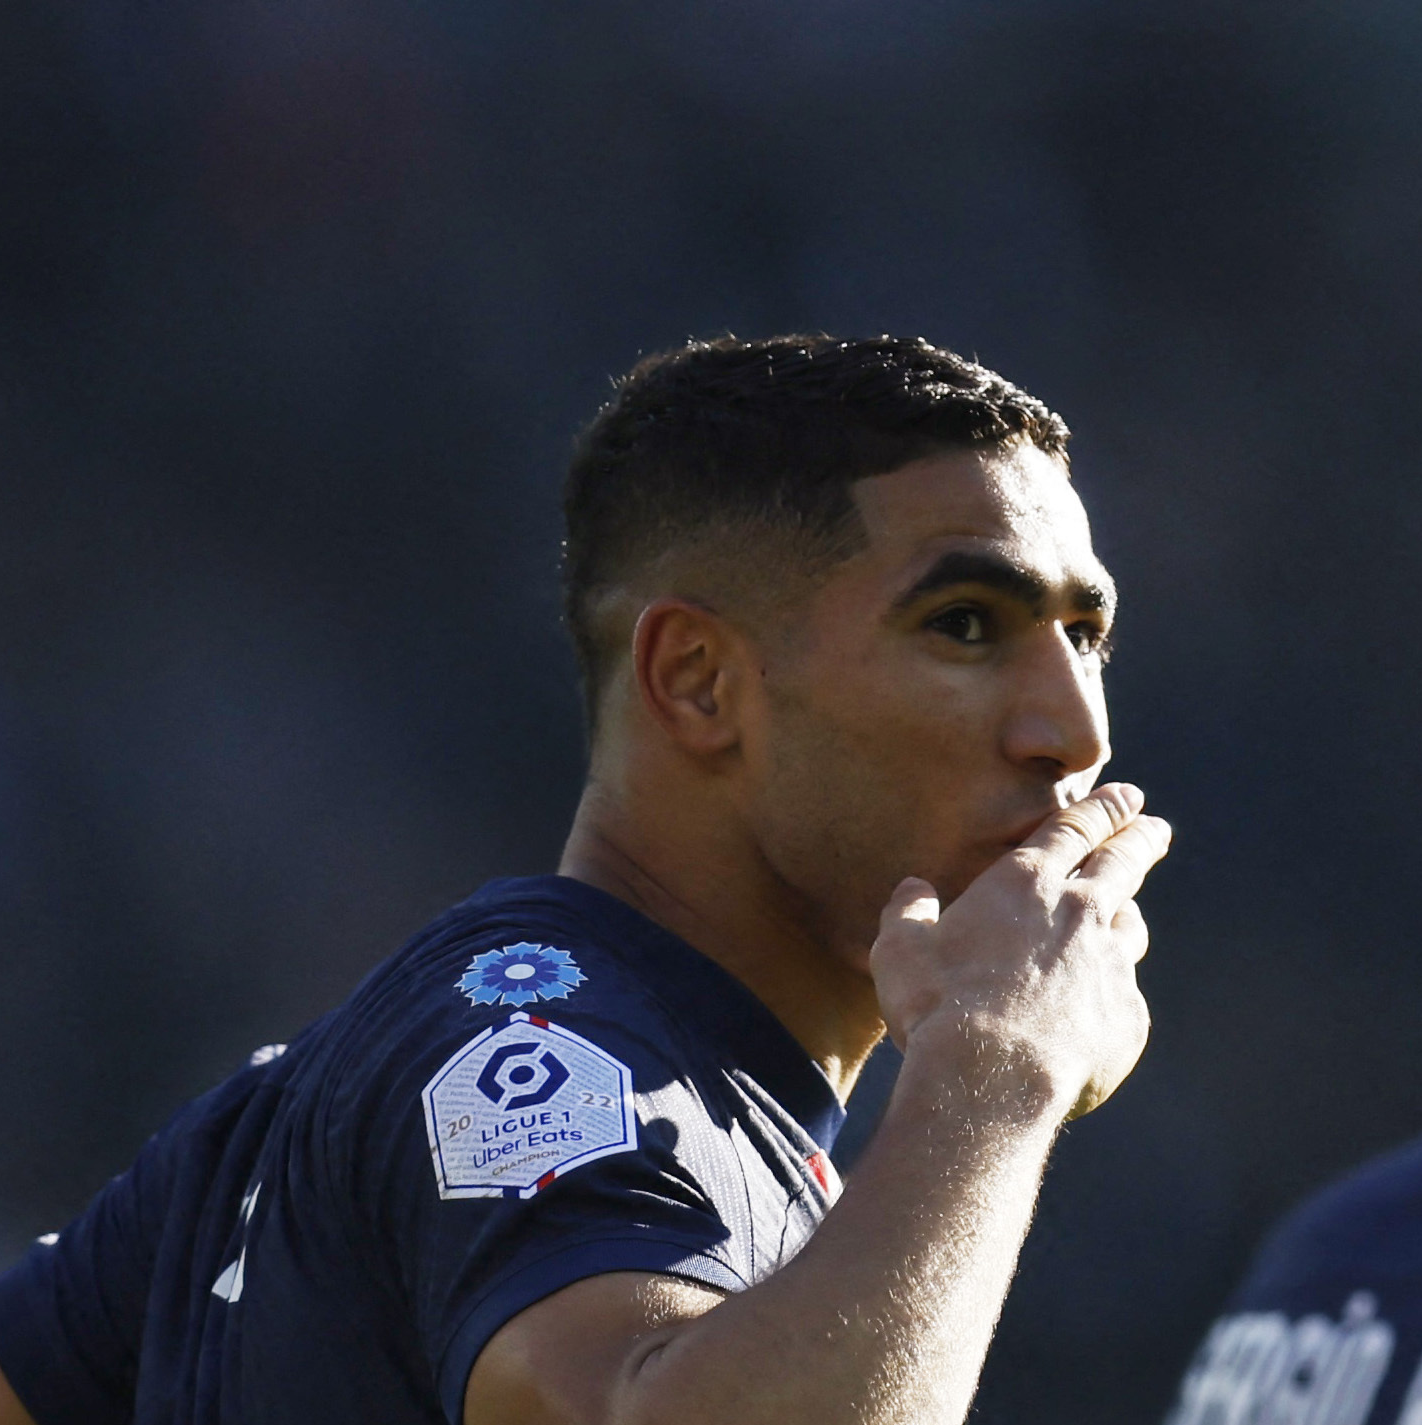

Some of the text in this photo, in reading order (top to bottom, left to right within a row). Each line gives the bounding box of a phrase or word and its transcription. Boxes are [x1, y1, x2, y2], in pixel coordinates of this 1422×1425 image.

[581, 1091, 613, 1109] 22
[447, 1115, 471, 1138] 20
[481, 1110, 571, 1143] LIGUE 1
[473, 1128, 583, 1168] Uber Eats
[492, 1149, 560, 1176] CHAMPION
